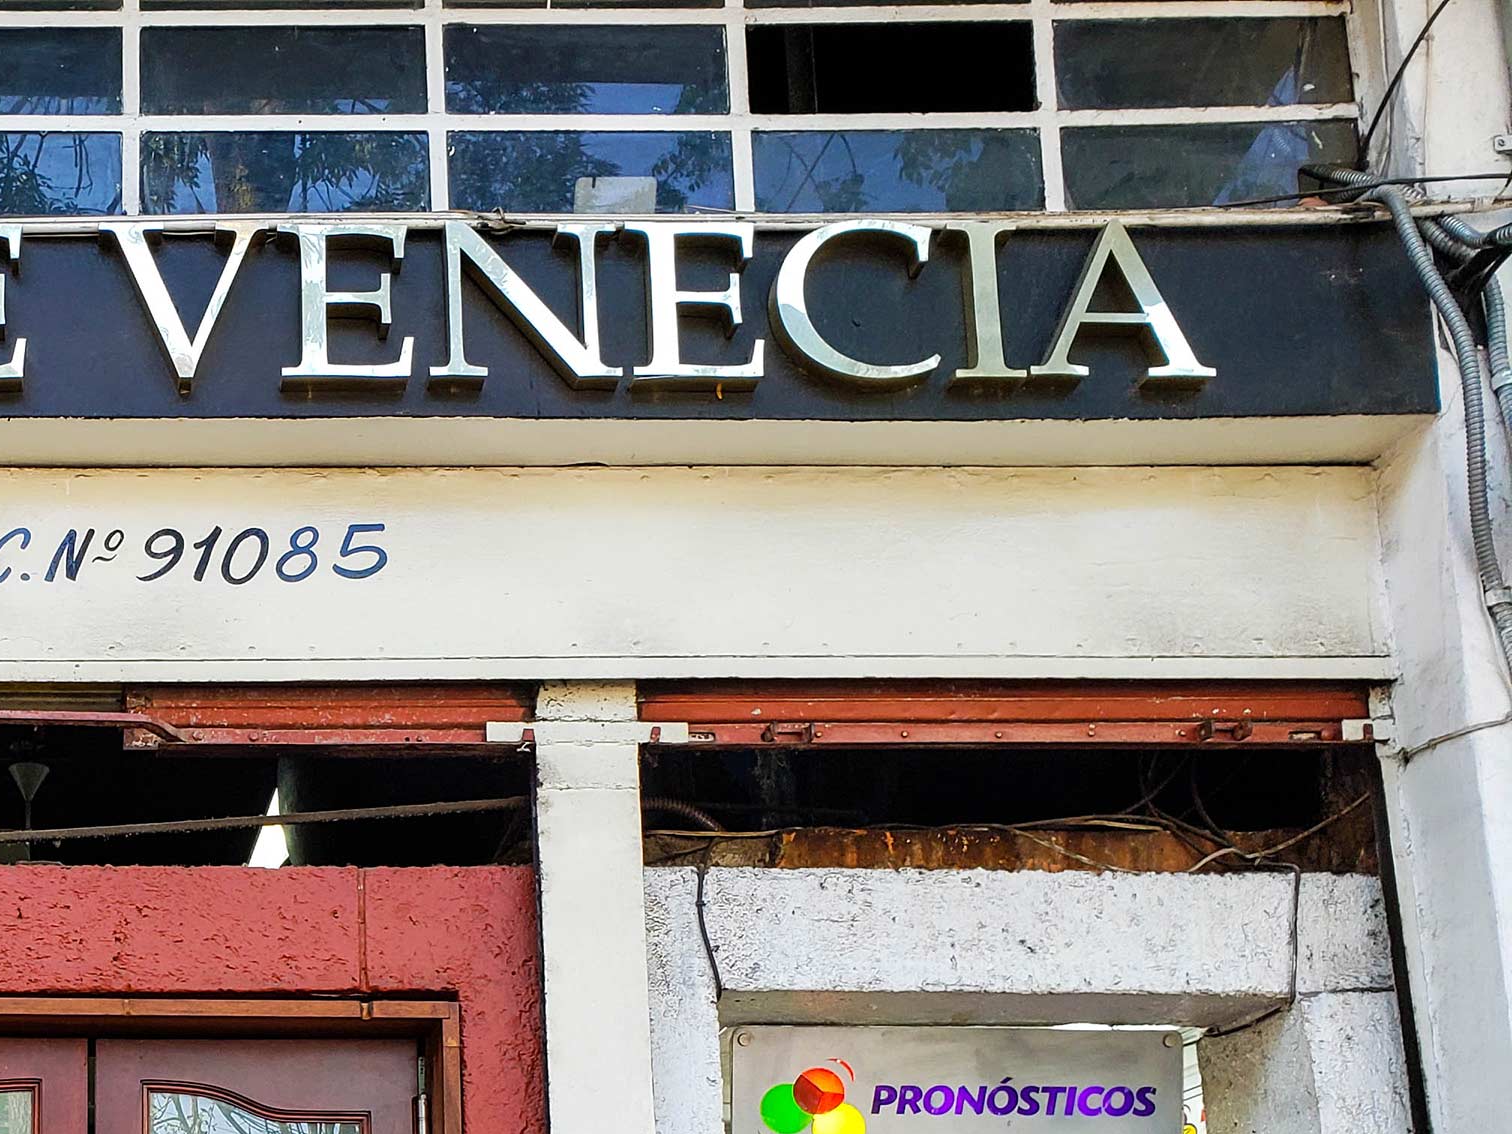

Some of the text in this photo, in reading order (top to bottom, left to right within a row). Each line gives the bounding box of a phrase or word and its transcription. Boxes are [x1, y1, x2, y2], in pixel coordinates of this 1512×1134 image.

[97, 218, 1218, 397] VENECIA
[136, 523, 388, 586] 91085
[871, 1077, 1157, 1117] PRONÓSTICOS
